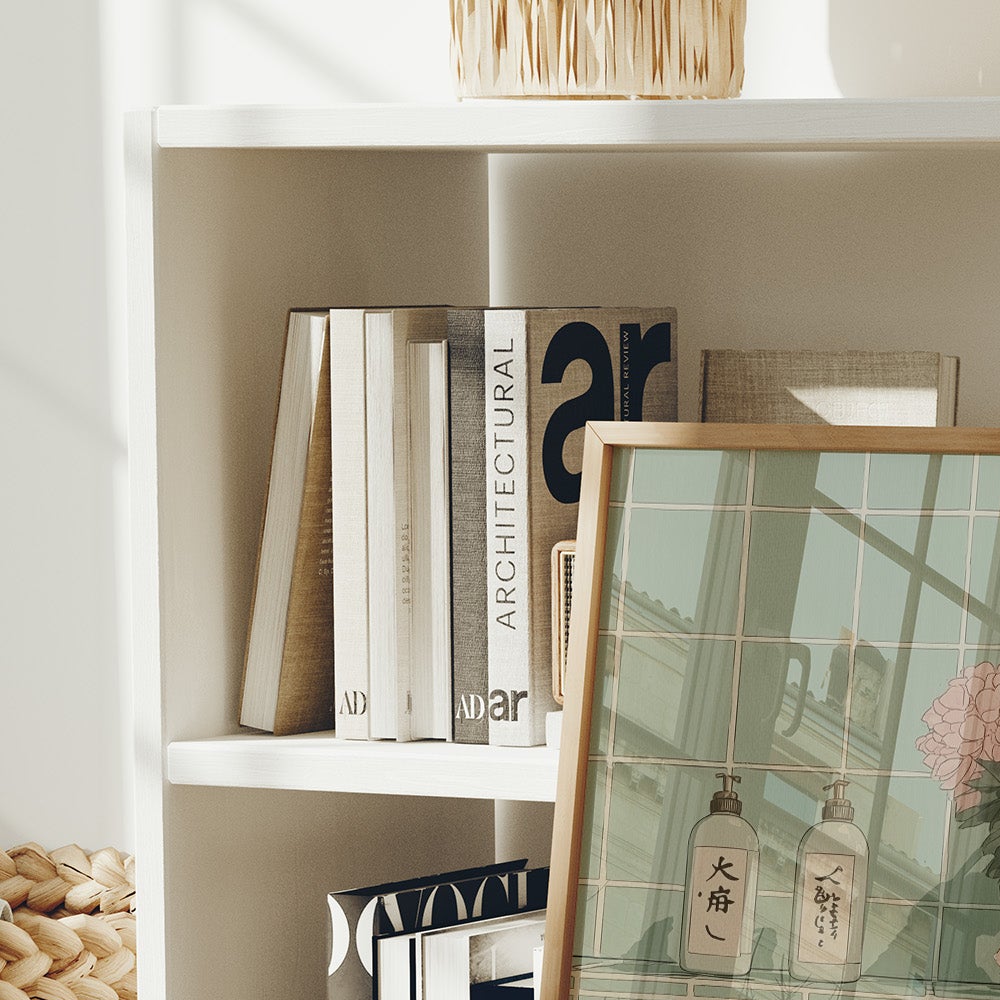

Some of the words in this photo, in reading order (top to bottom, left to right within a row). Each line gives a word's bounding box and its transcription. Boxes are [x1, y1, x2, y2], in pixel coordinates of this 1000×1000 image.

[541, 321, 671, 504] ar
[493, 337, 516, 630] ARCHITECTURAL
[339, 690, 367, 716] AD
[455, 694, 486, 720] AD
[489, 689, 528, 722] ar
